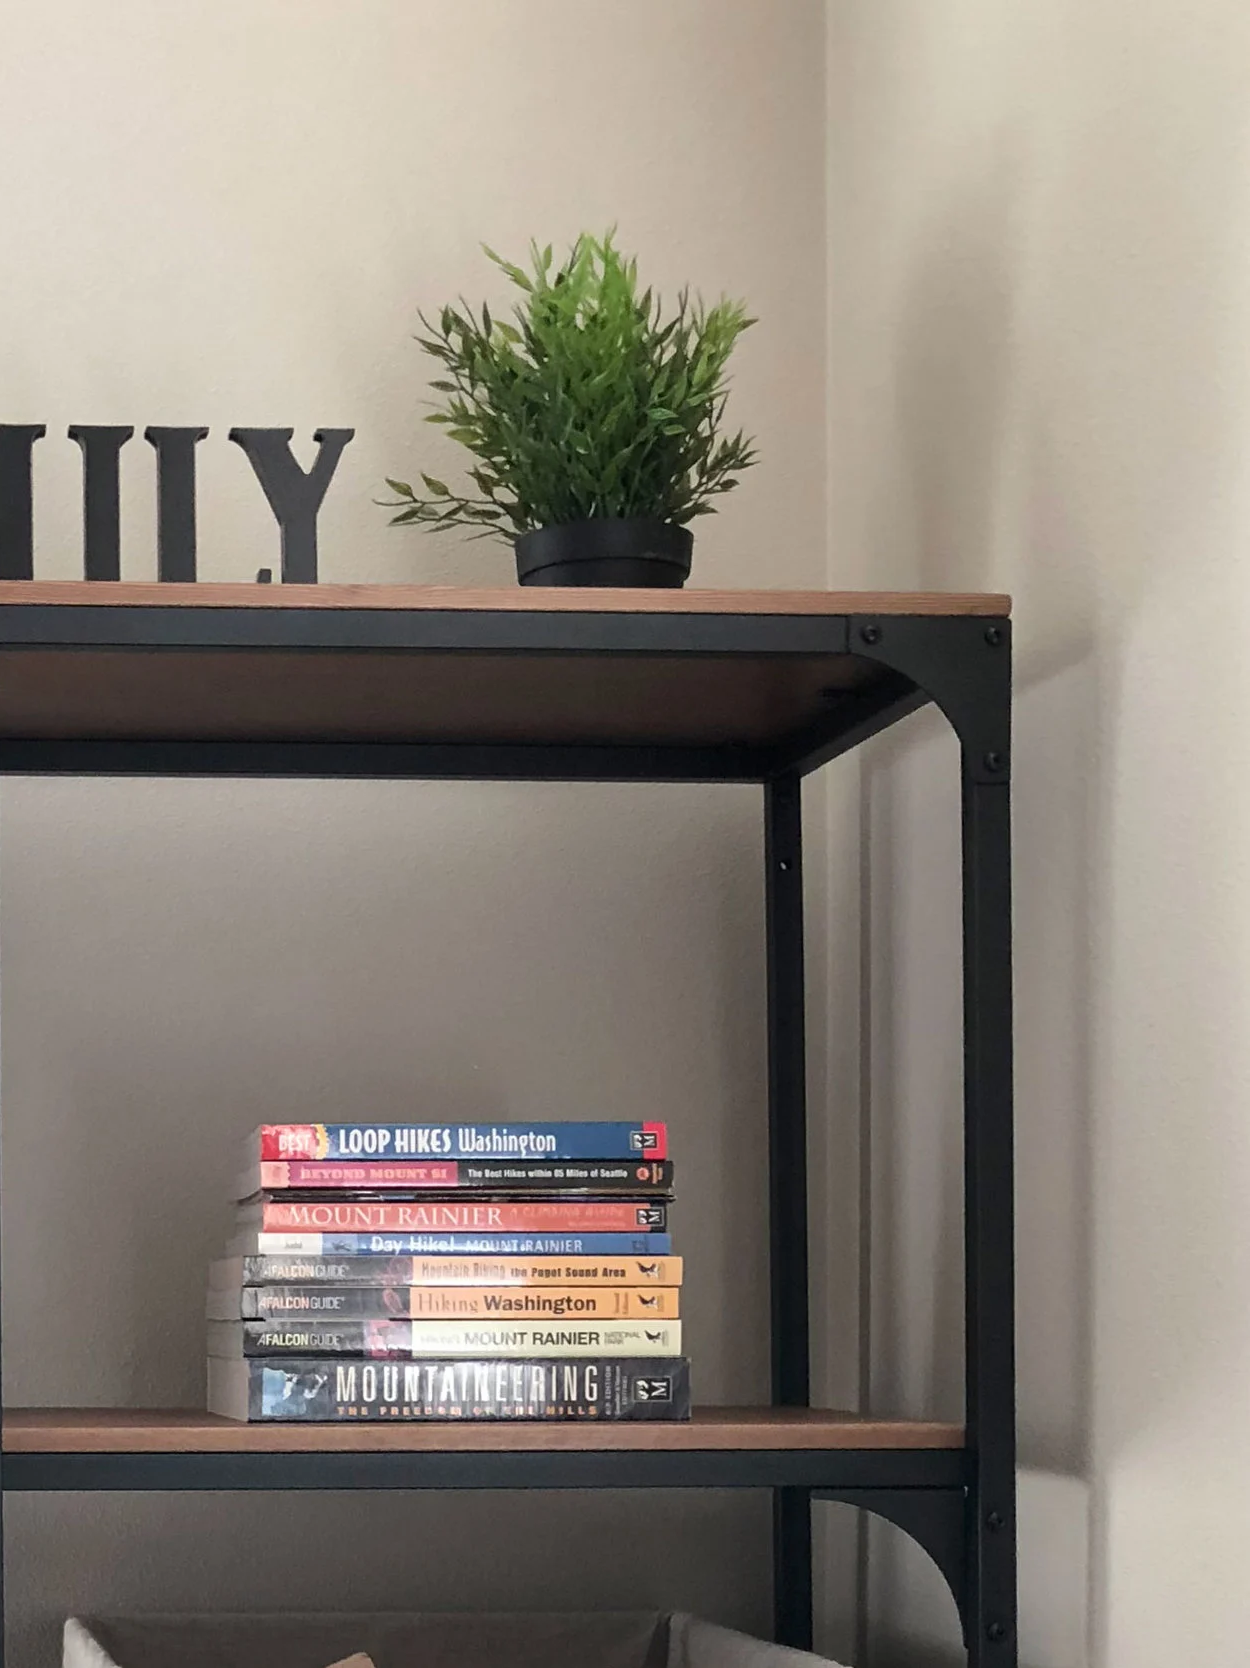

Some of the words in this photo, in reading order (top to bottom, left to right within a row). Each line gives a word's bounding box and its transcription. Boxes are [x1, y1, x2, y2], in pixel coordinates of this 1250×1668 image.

[339, 1128, 391, 1154] LOOP
[394, 1127, 452, 1154] HIKES
[458, 1127, 557, 1158] Washington
[369, 1167, 428, 1180] MOUNT
[468, 1168, 483, 1178] The
[484, 1168, 503, 1178] Best
[503, 1168, 527, 1178] Hikes
[528, 1168, 553, 1178] within
[566, 1168, 588, 1178] Miles
[590, 1168, 599, 1178] of
[600, 1168, 629, 1179] Seattle
[288, 1206, 393, 1226] MOUNT
[397, 1206, 503, 1227] RAINIER
[370, 1235, 403, 1255] Day
[465, 1239, 518, 1252] MOUNT
[524, 1239, 583, 1252] RAINIER
[531, 1266, 562, 1279] Puget
[565, 1267, 598, 1278] Sound
[602, 1267, 627, 1278] Area
[418, 1293, 480, 1315] Hiking
[483, 1294, 597, 1314] Washington
[464, 1332, 528, 1346] MOUNT
[532, 1331, 600, 1346] RAINIER
[336, 1365, 598, 1402] MOUNTAINEERING
[337, 1406, 369, 1415] THE
[379, 1405, 462, 1416] FREEDOM
[546, 1405, 598, 1416] HILLS
